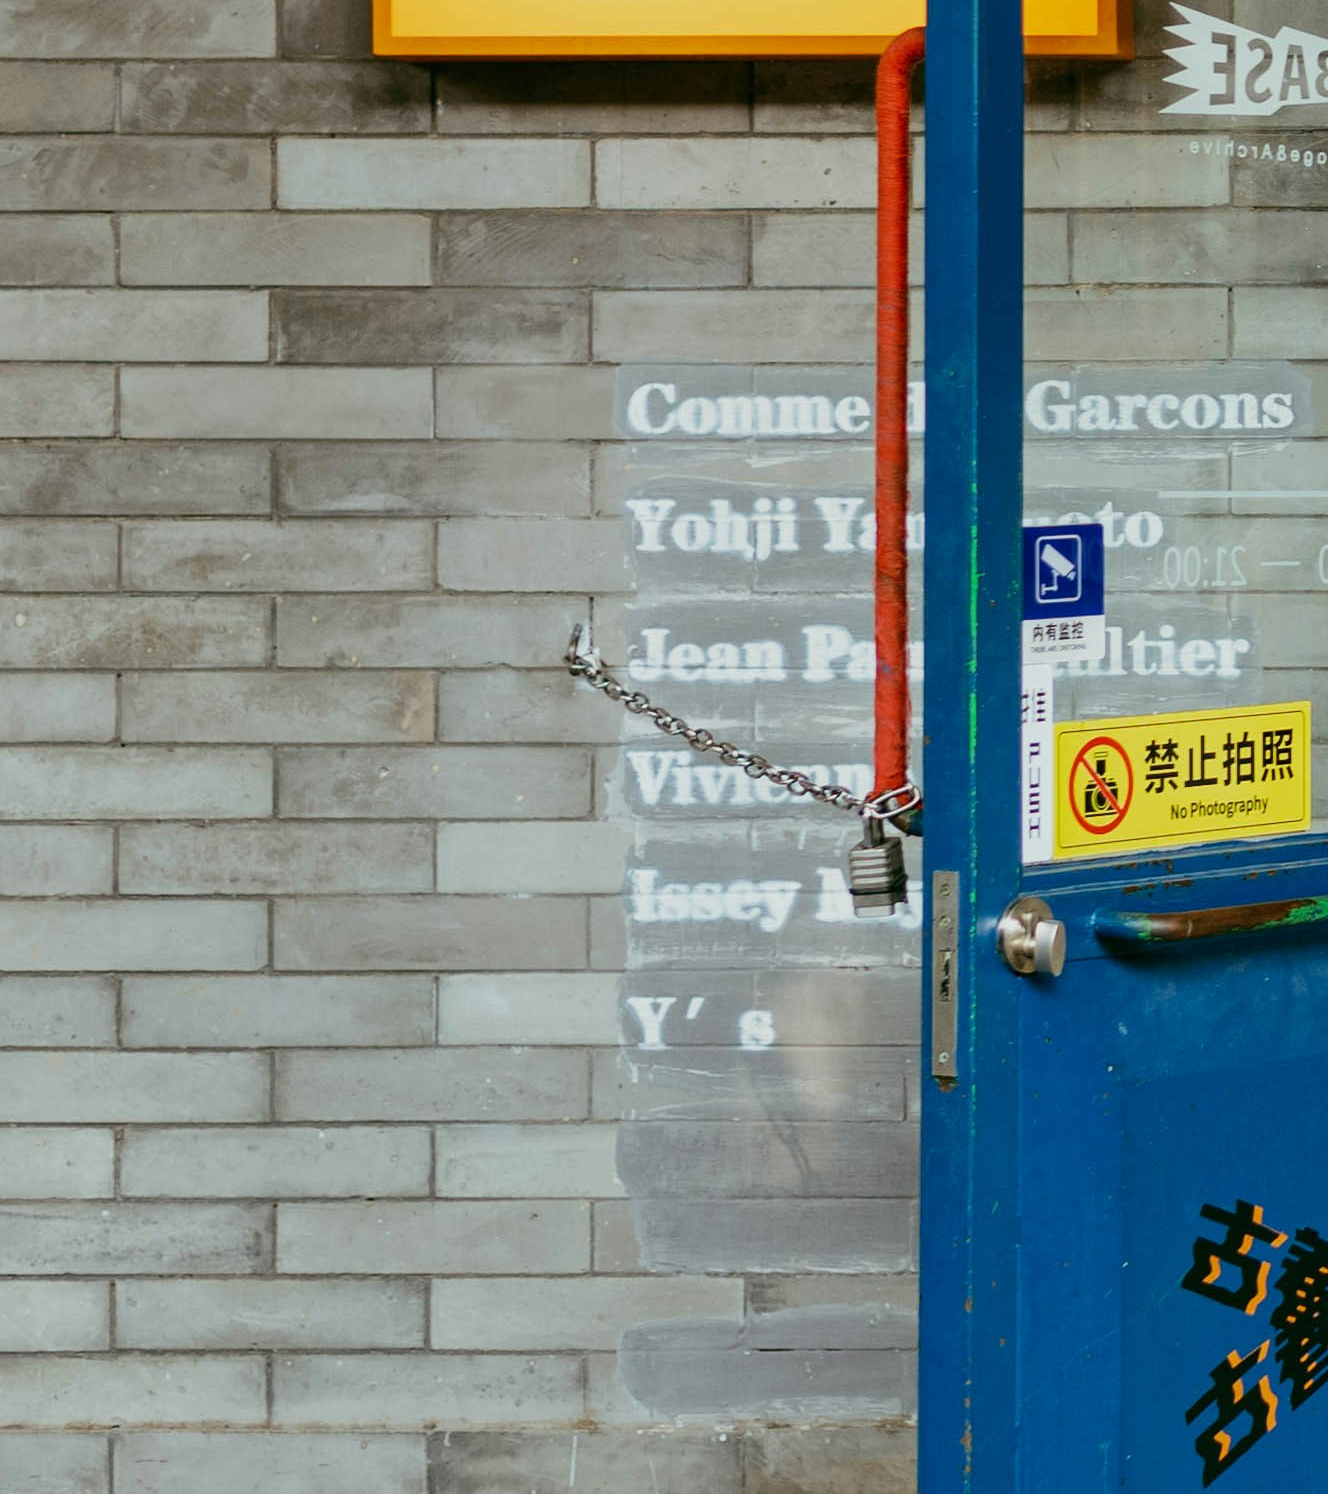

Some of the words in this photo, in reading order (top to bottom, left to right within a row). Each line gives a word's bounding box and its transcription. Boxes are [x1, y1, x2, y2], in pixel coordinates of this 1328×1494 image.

[626, 382, 871, 435] Comme
[1024, 379, 1294, 432] Garcons
[626, 497, 798, 561] Yohji
[627, 627, 788, 683] Jean
[1032, 621, 1085, 643] 内有监控
[1028, 741, 1041, 840] PUSH
[1144, 728, 1294, 794] 禁止拍照
[1170, 804, 1188, 820] No
[1191, 795, 1269, 821] Photography
[628, 868, 802, 933] Issey
